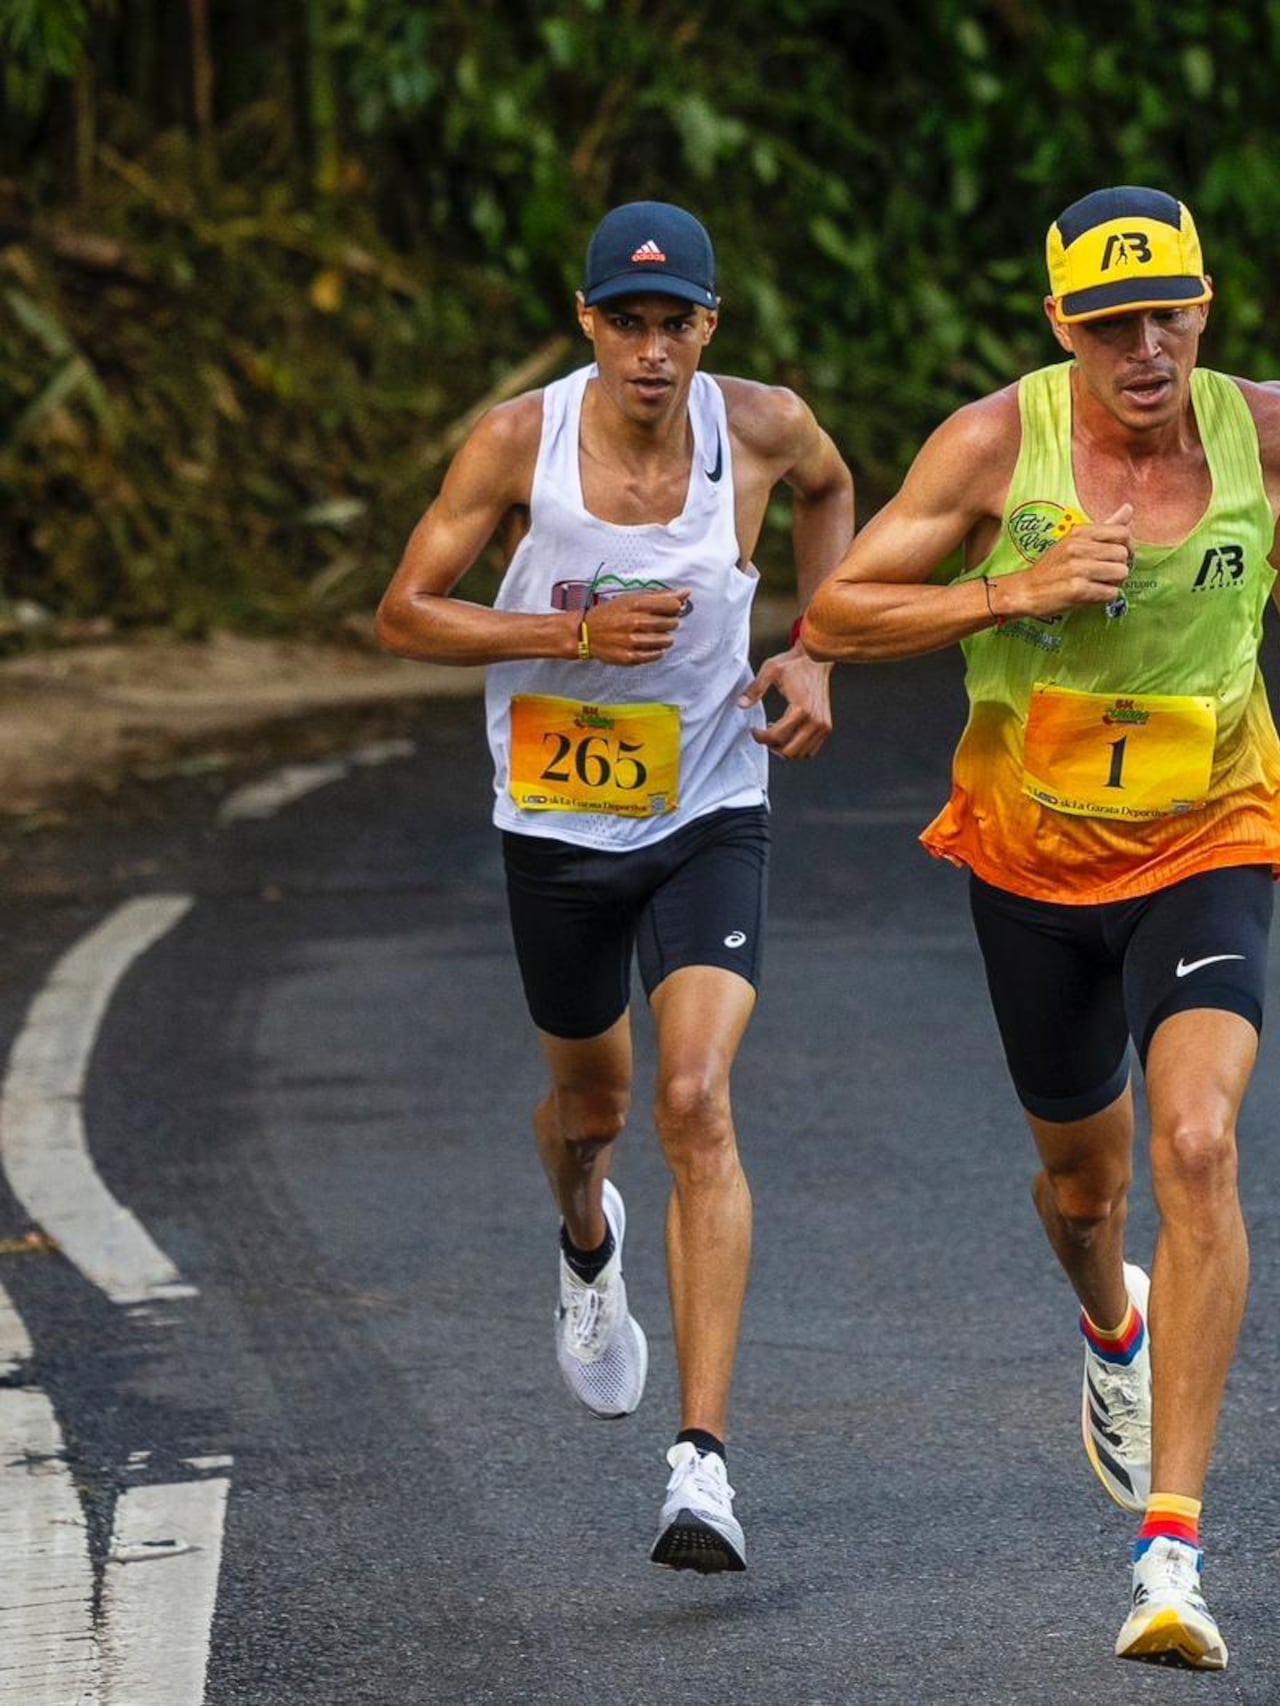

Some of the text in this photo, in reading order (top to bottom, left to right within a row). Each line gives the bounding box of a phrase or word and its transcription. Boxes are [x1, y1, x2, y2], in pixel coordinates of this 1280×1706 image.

[631, 252, 667, 262] adidas
[540, 732, 647, 790] 265
[1103, 735, 1128, 789] 1
